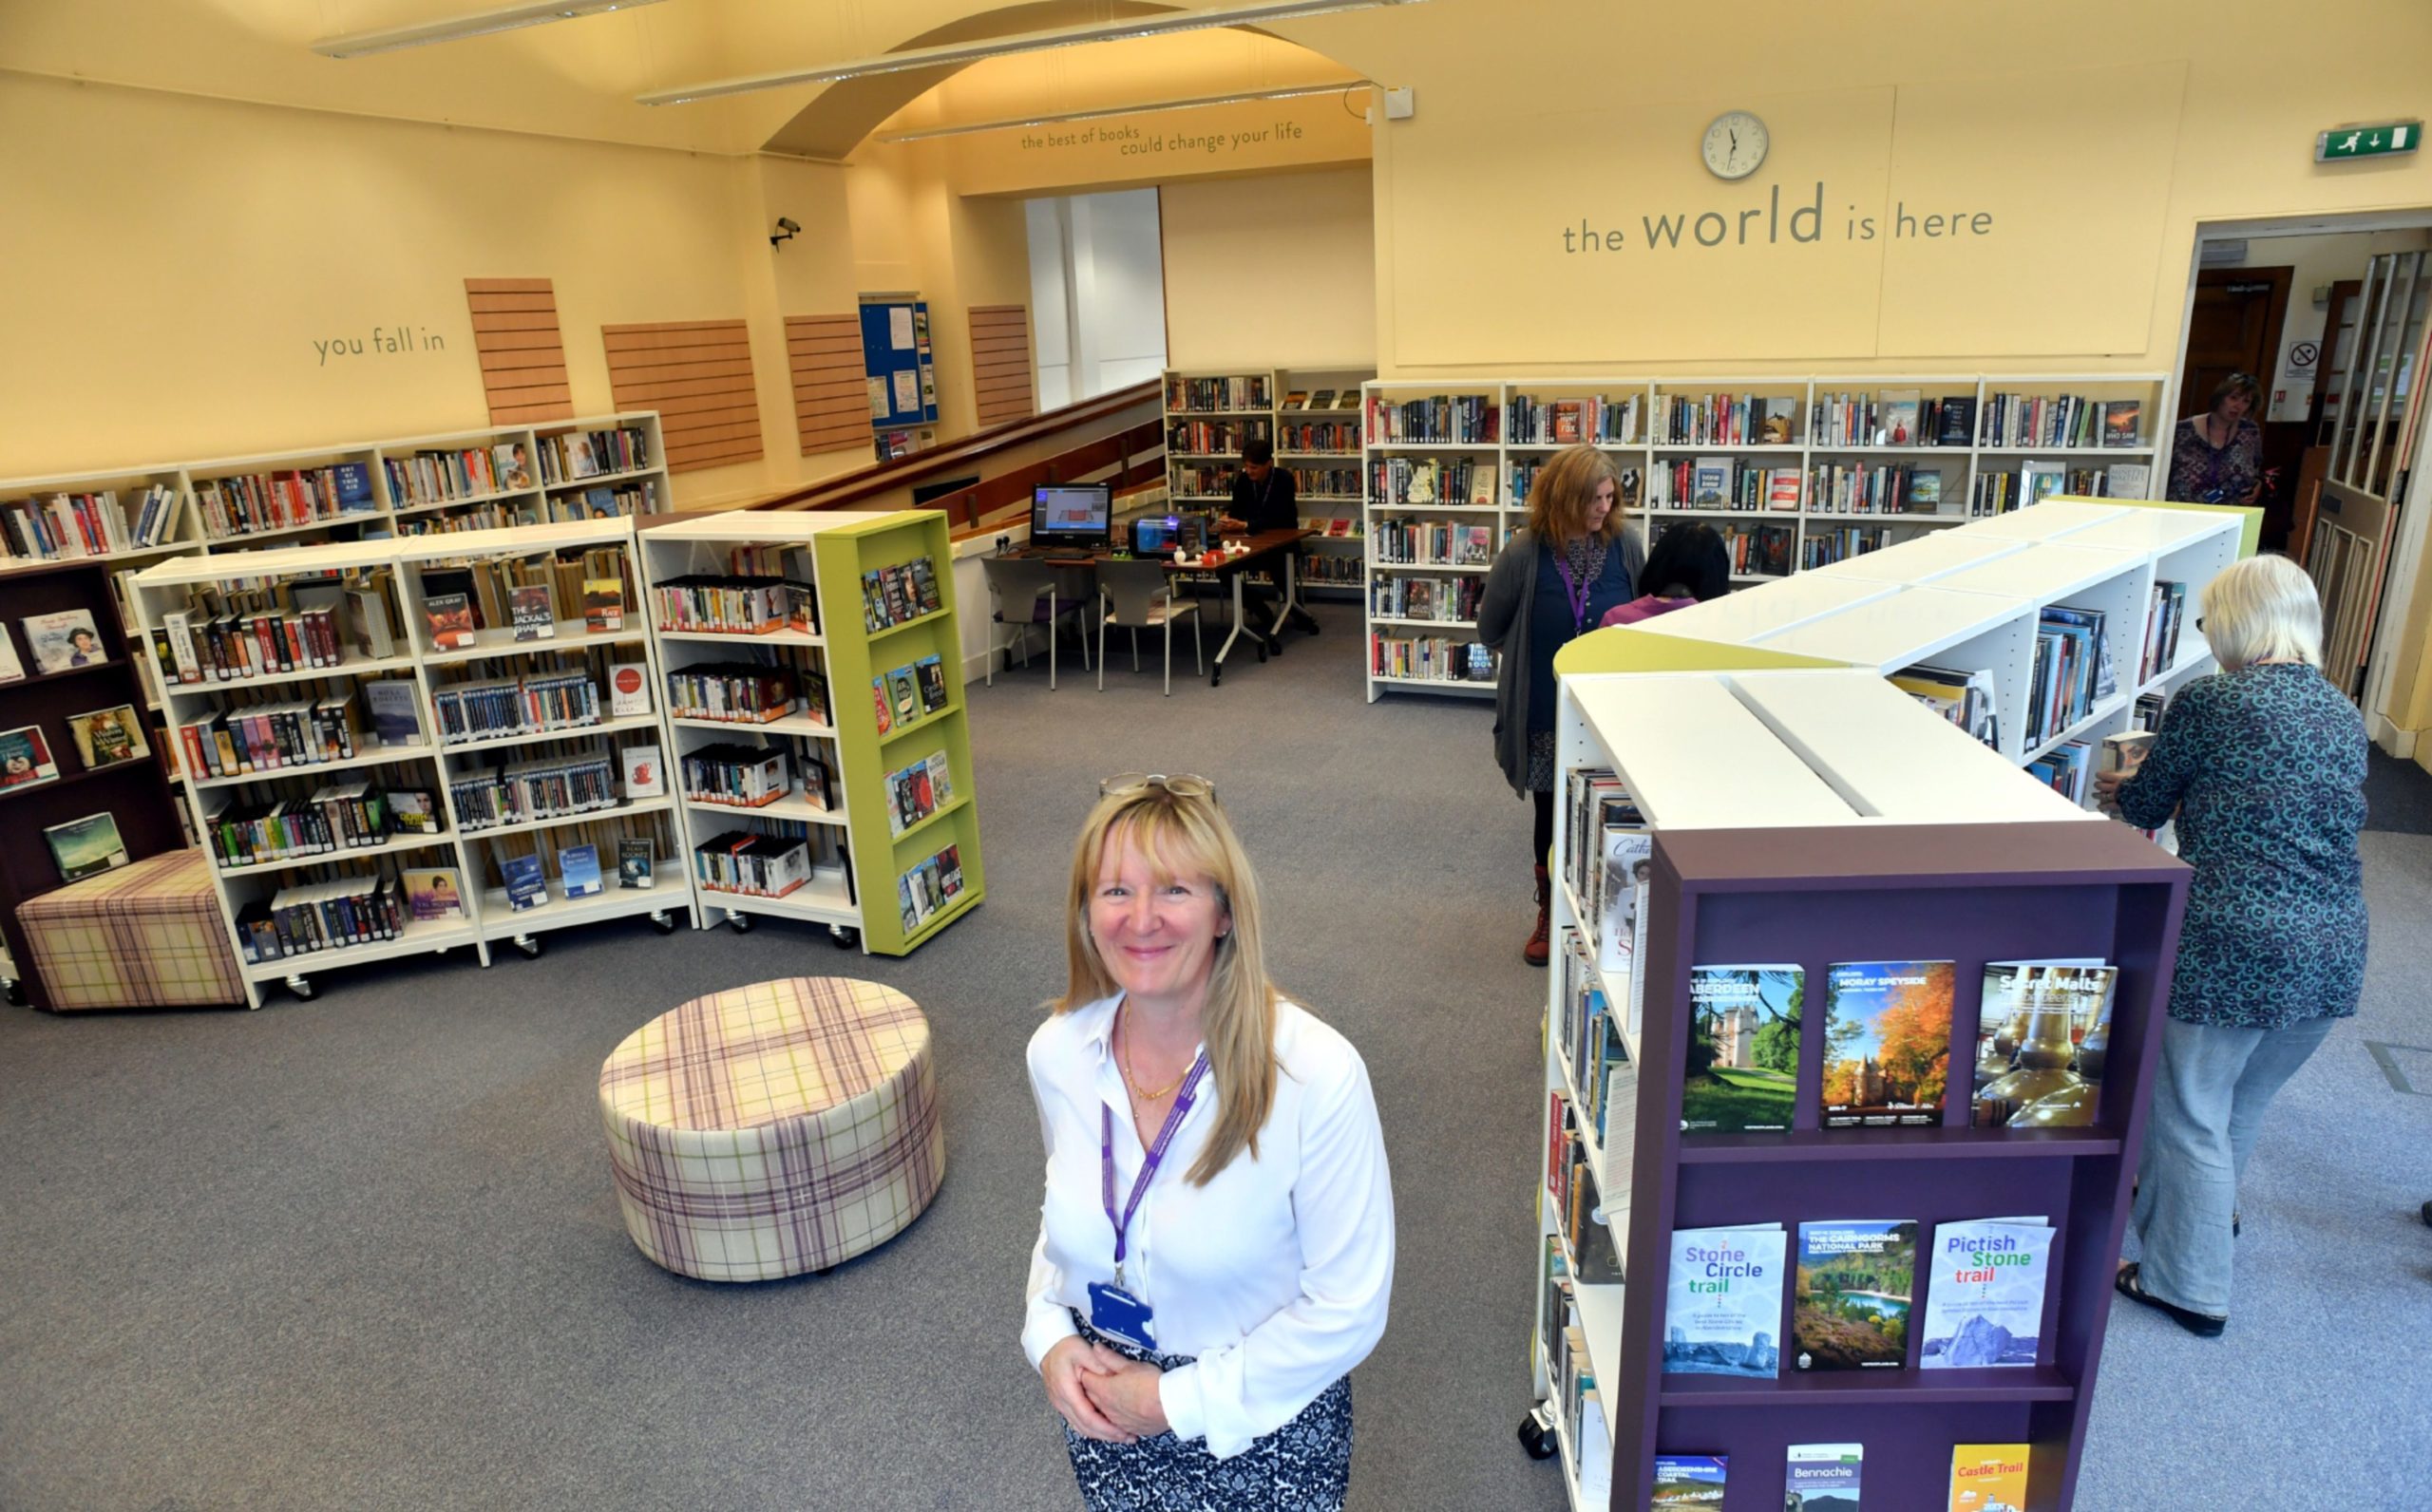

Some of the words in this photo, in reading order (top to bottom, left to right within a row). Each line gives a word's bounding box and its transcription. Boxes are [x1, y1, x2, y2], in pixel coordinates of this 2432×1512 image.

[1022, 135, 1043, 150] the
[1048, 132, 1075, 147] best
[1081, 127, 1095, 143] of
[1099, 124, 1140, 142] books
[1121, 137, 1162, 156] could
[1168, 133, 1225, 153] change
[1231, 130, 1269, 151] your
[1275, 122, 1302, 141] life
[1563, 218, 1624, 254] the
[1642, 181, 1823, 250] world
[1848, 204, 1875, 240] is
[1896, 201, 1993, 238] here
[313, 338, 364, 368] you
[372, 326, 414, 353] fall
[420, 326, 446, 351] in
[1839, 977, 1877, 987] MORAY
[1877, 976, 1928, 986] SPEYSIDE
[2055, 975, 2102, 991] Malts
[1808, 1242, 1856, 1251] NATIONAL
[1857, 1241, 1885, 1250] PARK
[1829, 1234, 1901, 1243] CAIRNGORMS
[1948, 1235, 2017, 1253] Pictish
[1685, 1247, 1745, 1262] Stone
[1971, 1250, 2032, 1267] Stone
[1705, 1261, 1763, 1277] Circle
[1954, 1265, 1995, 1283] trail
[1688, 1277, 1729, 1293] trail
[1794, 1465, 1853, 1478] Bennachie
[1958, 1465, 1995, 1478] Castle
[1998, 1463, 2024, 1474] Trail
